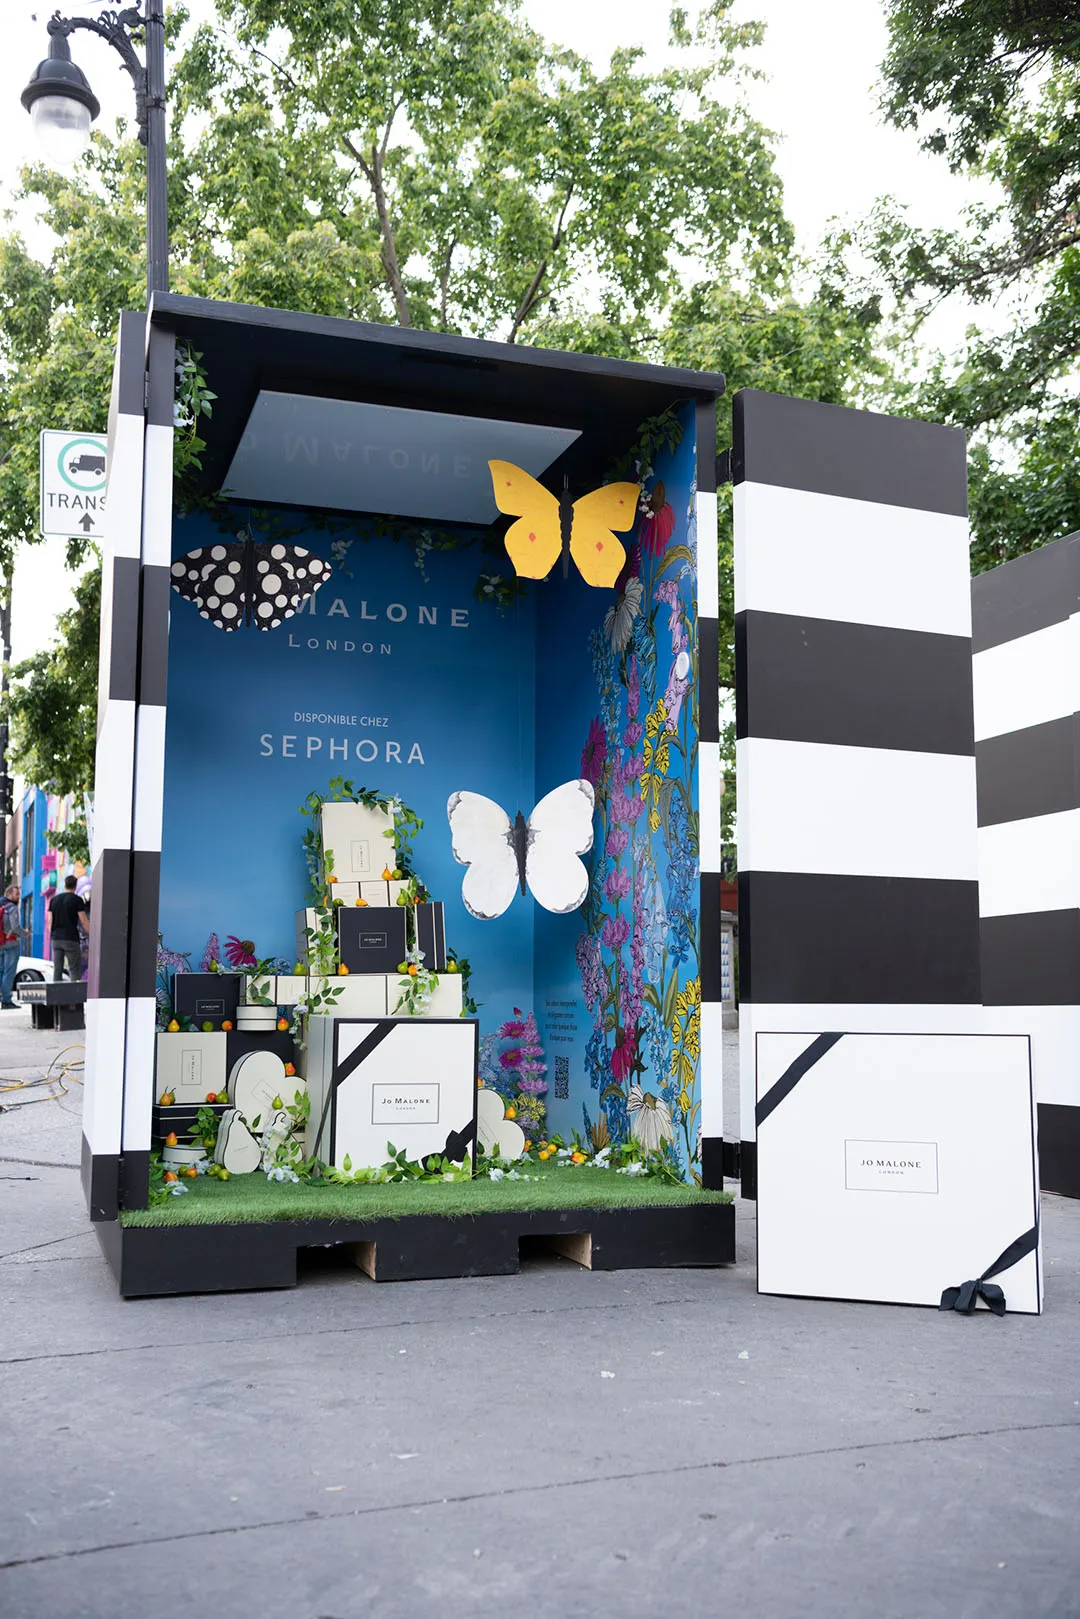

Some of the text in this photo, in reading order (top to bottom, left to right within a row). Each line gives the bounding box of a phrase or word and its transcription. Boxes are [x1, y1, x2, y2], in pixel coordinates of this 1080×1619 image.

[288, 633, 392, 655] LONDON
[294, 711, 389, 728] DISPONIBLE CHEZ
[259, 733, 425, 765] SEPHORA
[877, 1160, 922, 1168] MALONE
